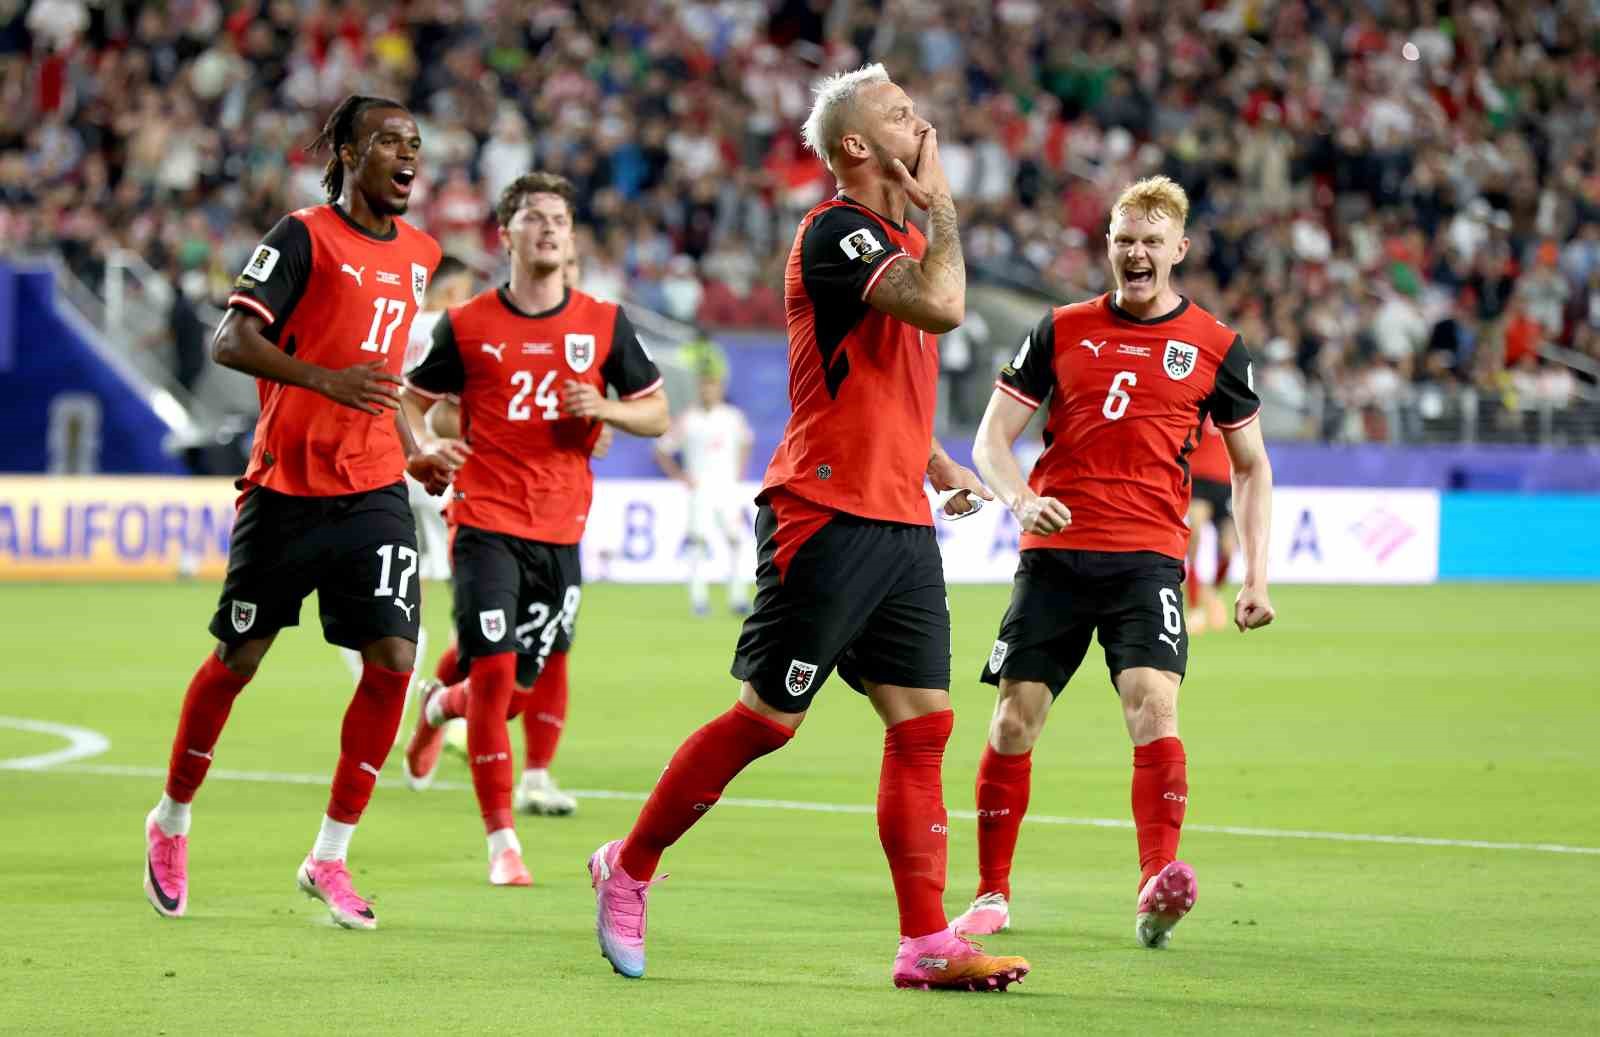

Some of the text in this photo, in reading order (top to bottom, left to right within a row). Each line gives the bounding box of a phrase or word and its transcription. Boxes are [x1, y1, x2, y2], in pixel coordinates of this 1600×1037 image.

[361, 297, 407, 354] 17
[507, 369, 561, 421] 24
[1102, 371, 1137, 420] 6
[374, 544, 418, 599] 17
[1159, 587, 1181, 635] 6
